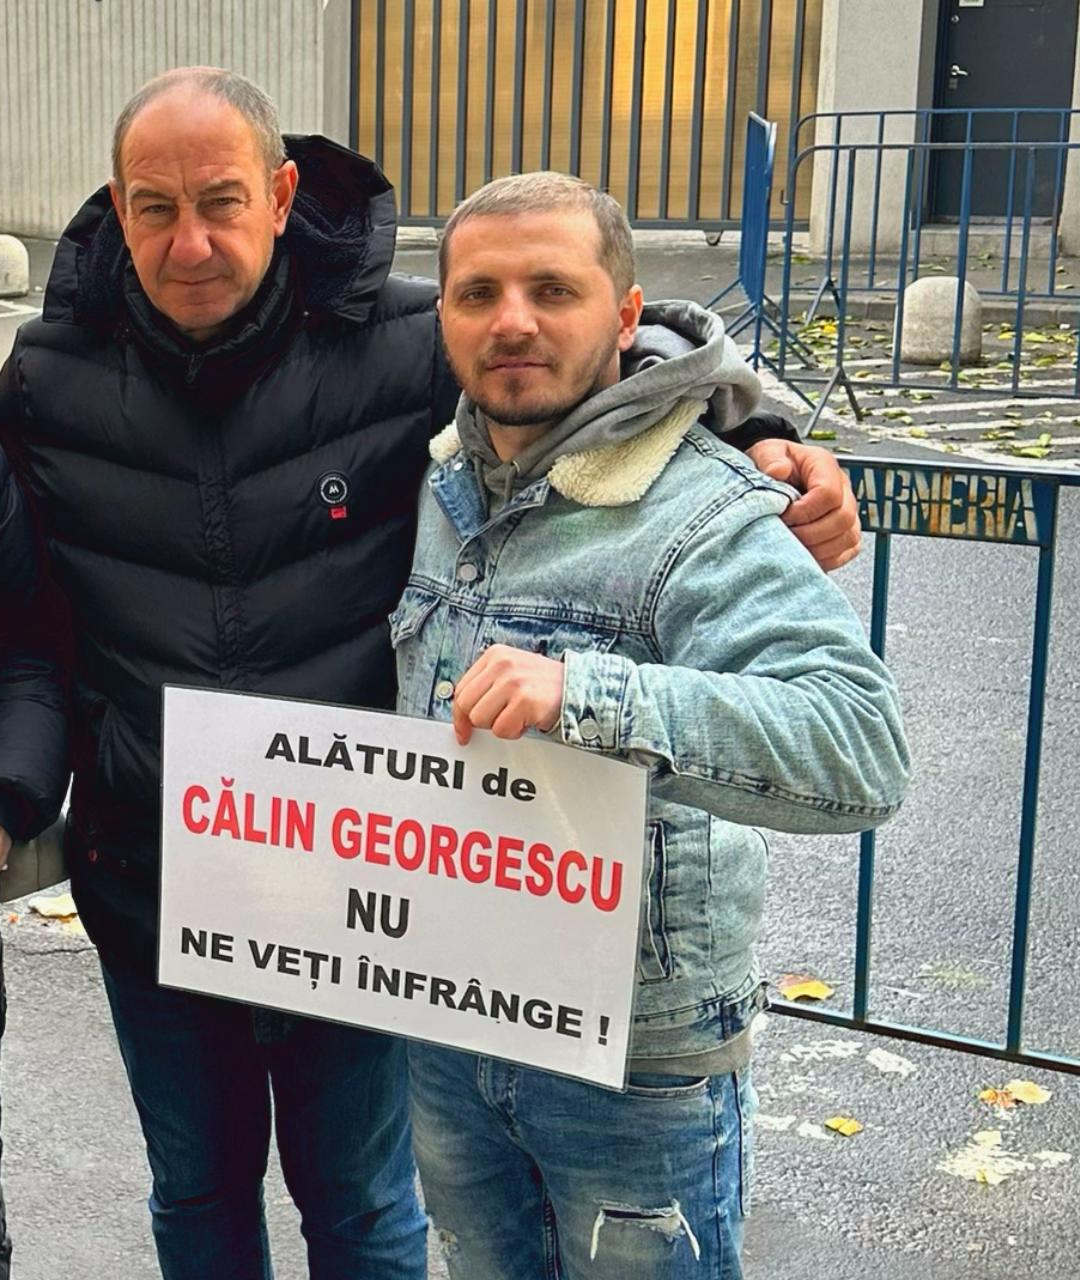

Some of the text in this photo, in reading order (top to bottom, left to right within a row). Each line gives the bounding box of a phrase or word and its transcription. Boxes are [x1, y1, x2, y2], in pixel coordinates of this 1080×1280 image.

[264, 732, 537, 802] ALĂTURI de
[182, 776, 623, 912] CĂLIN GEORGESCU
[346, 887, 410, 939] NU
[181, 926, 235, 963] NE
[247, 939, 342, 990] VEȚI
[356, 956, 584, 1039] ÎNFRÂNGE
